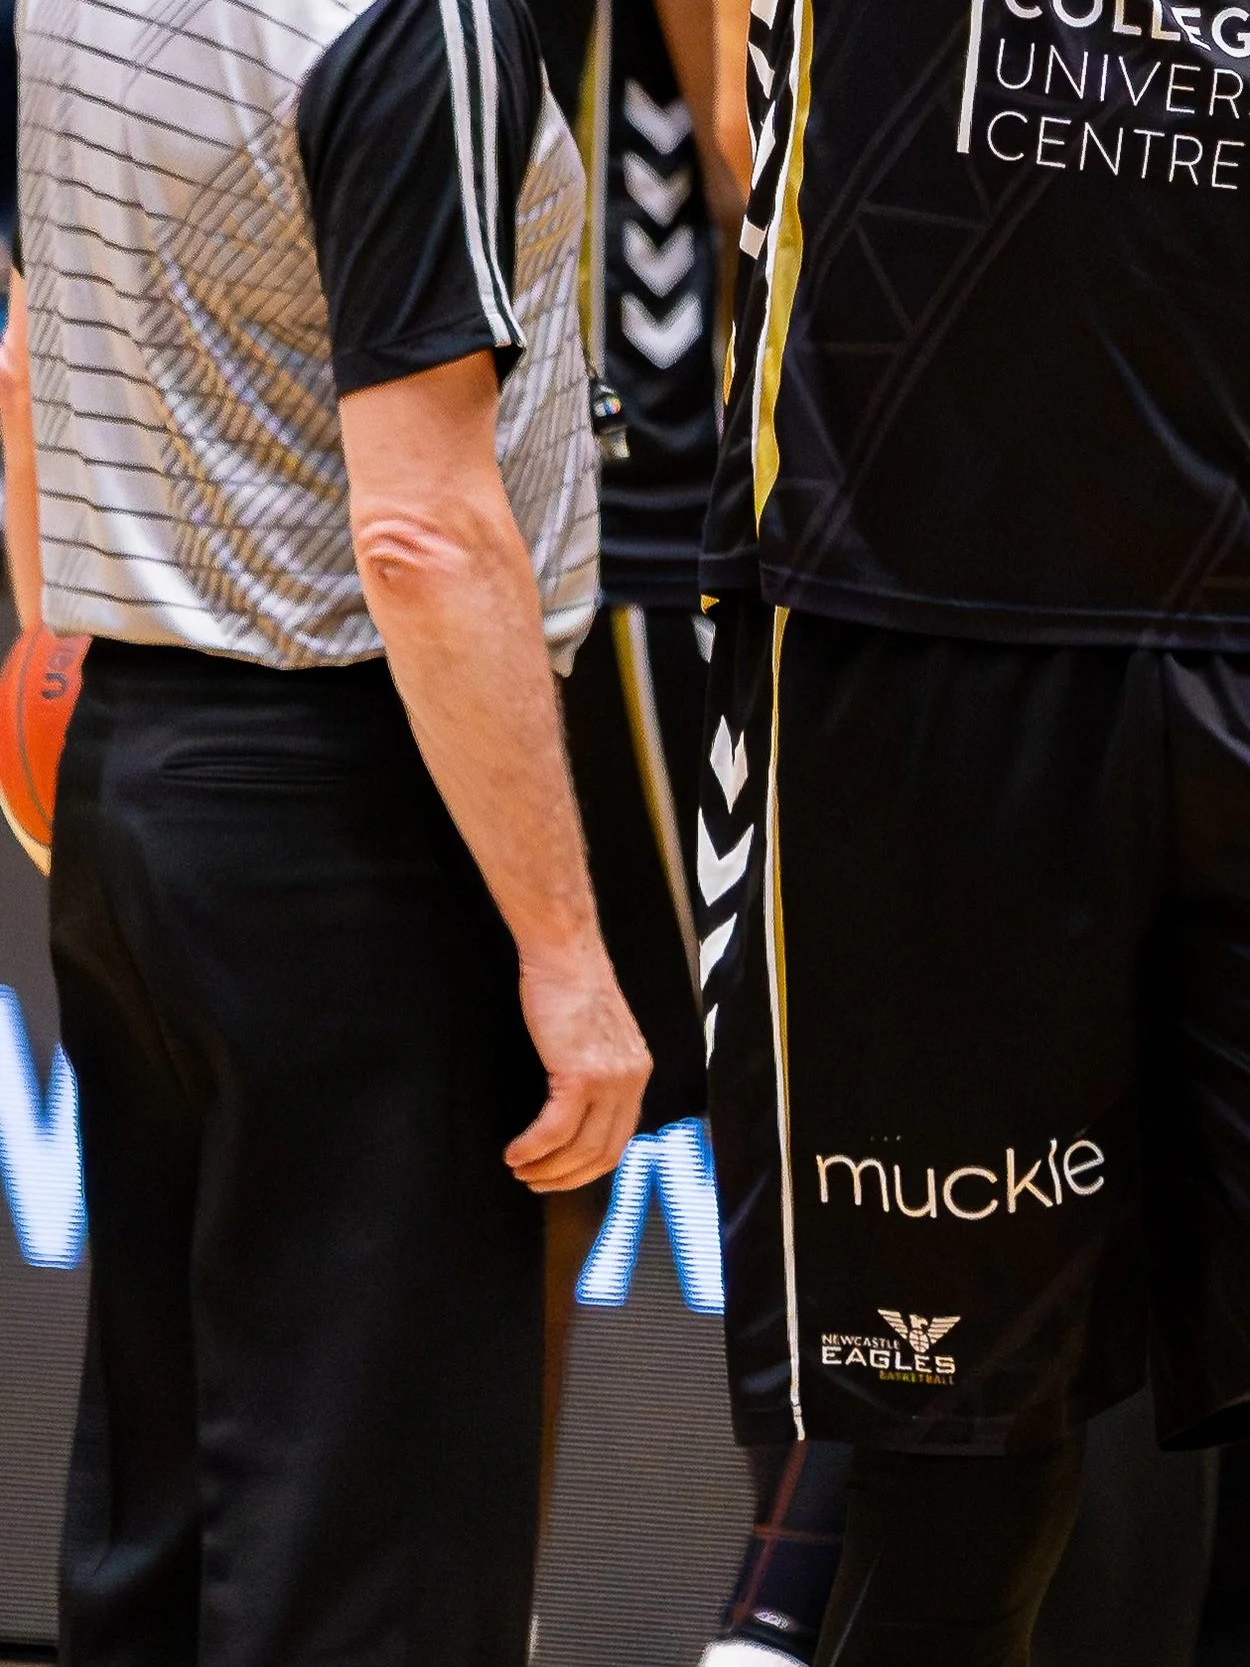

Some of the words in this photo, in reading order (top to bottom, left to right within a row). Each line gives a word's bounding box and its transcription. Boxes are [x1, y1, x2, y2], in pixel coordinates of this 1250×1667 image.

[986, 111, 1245, 191] CENTRE
[821, 1334, 900, 1351] NEWCASTLE
[822, 1345, 956, 1375] EAGLES
[879, 1371, 955, 1385] BASKETBALL
